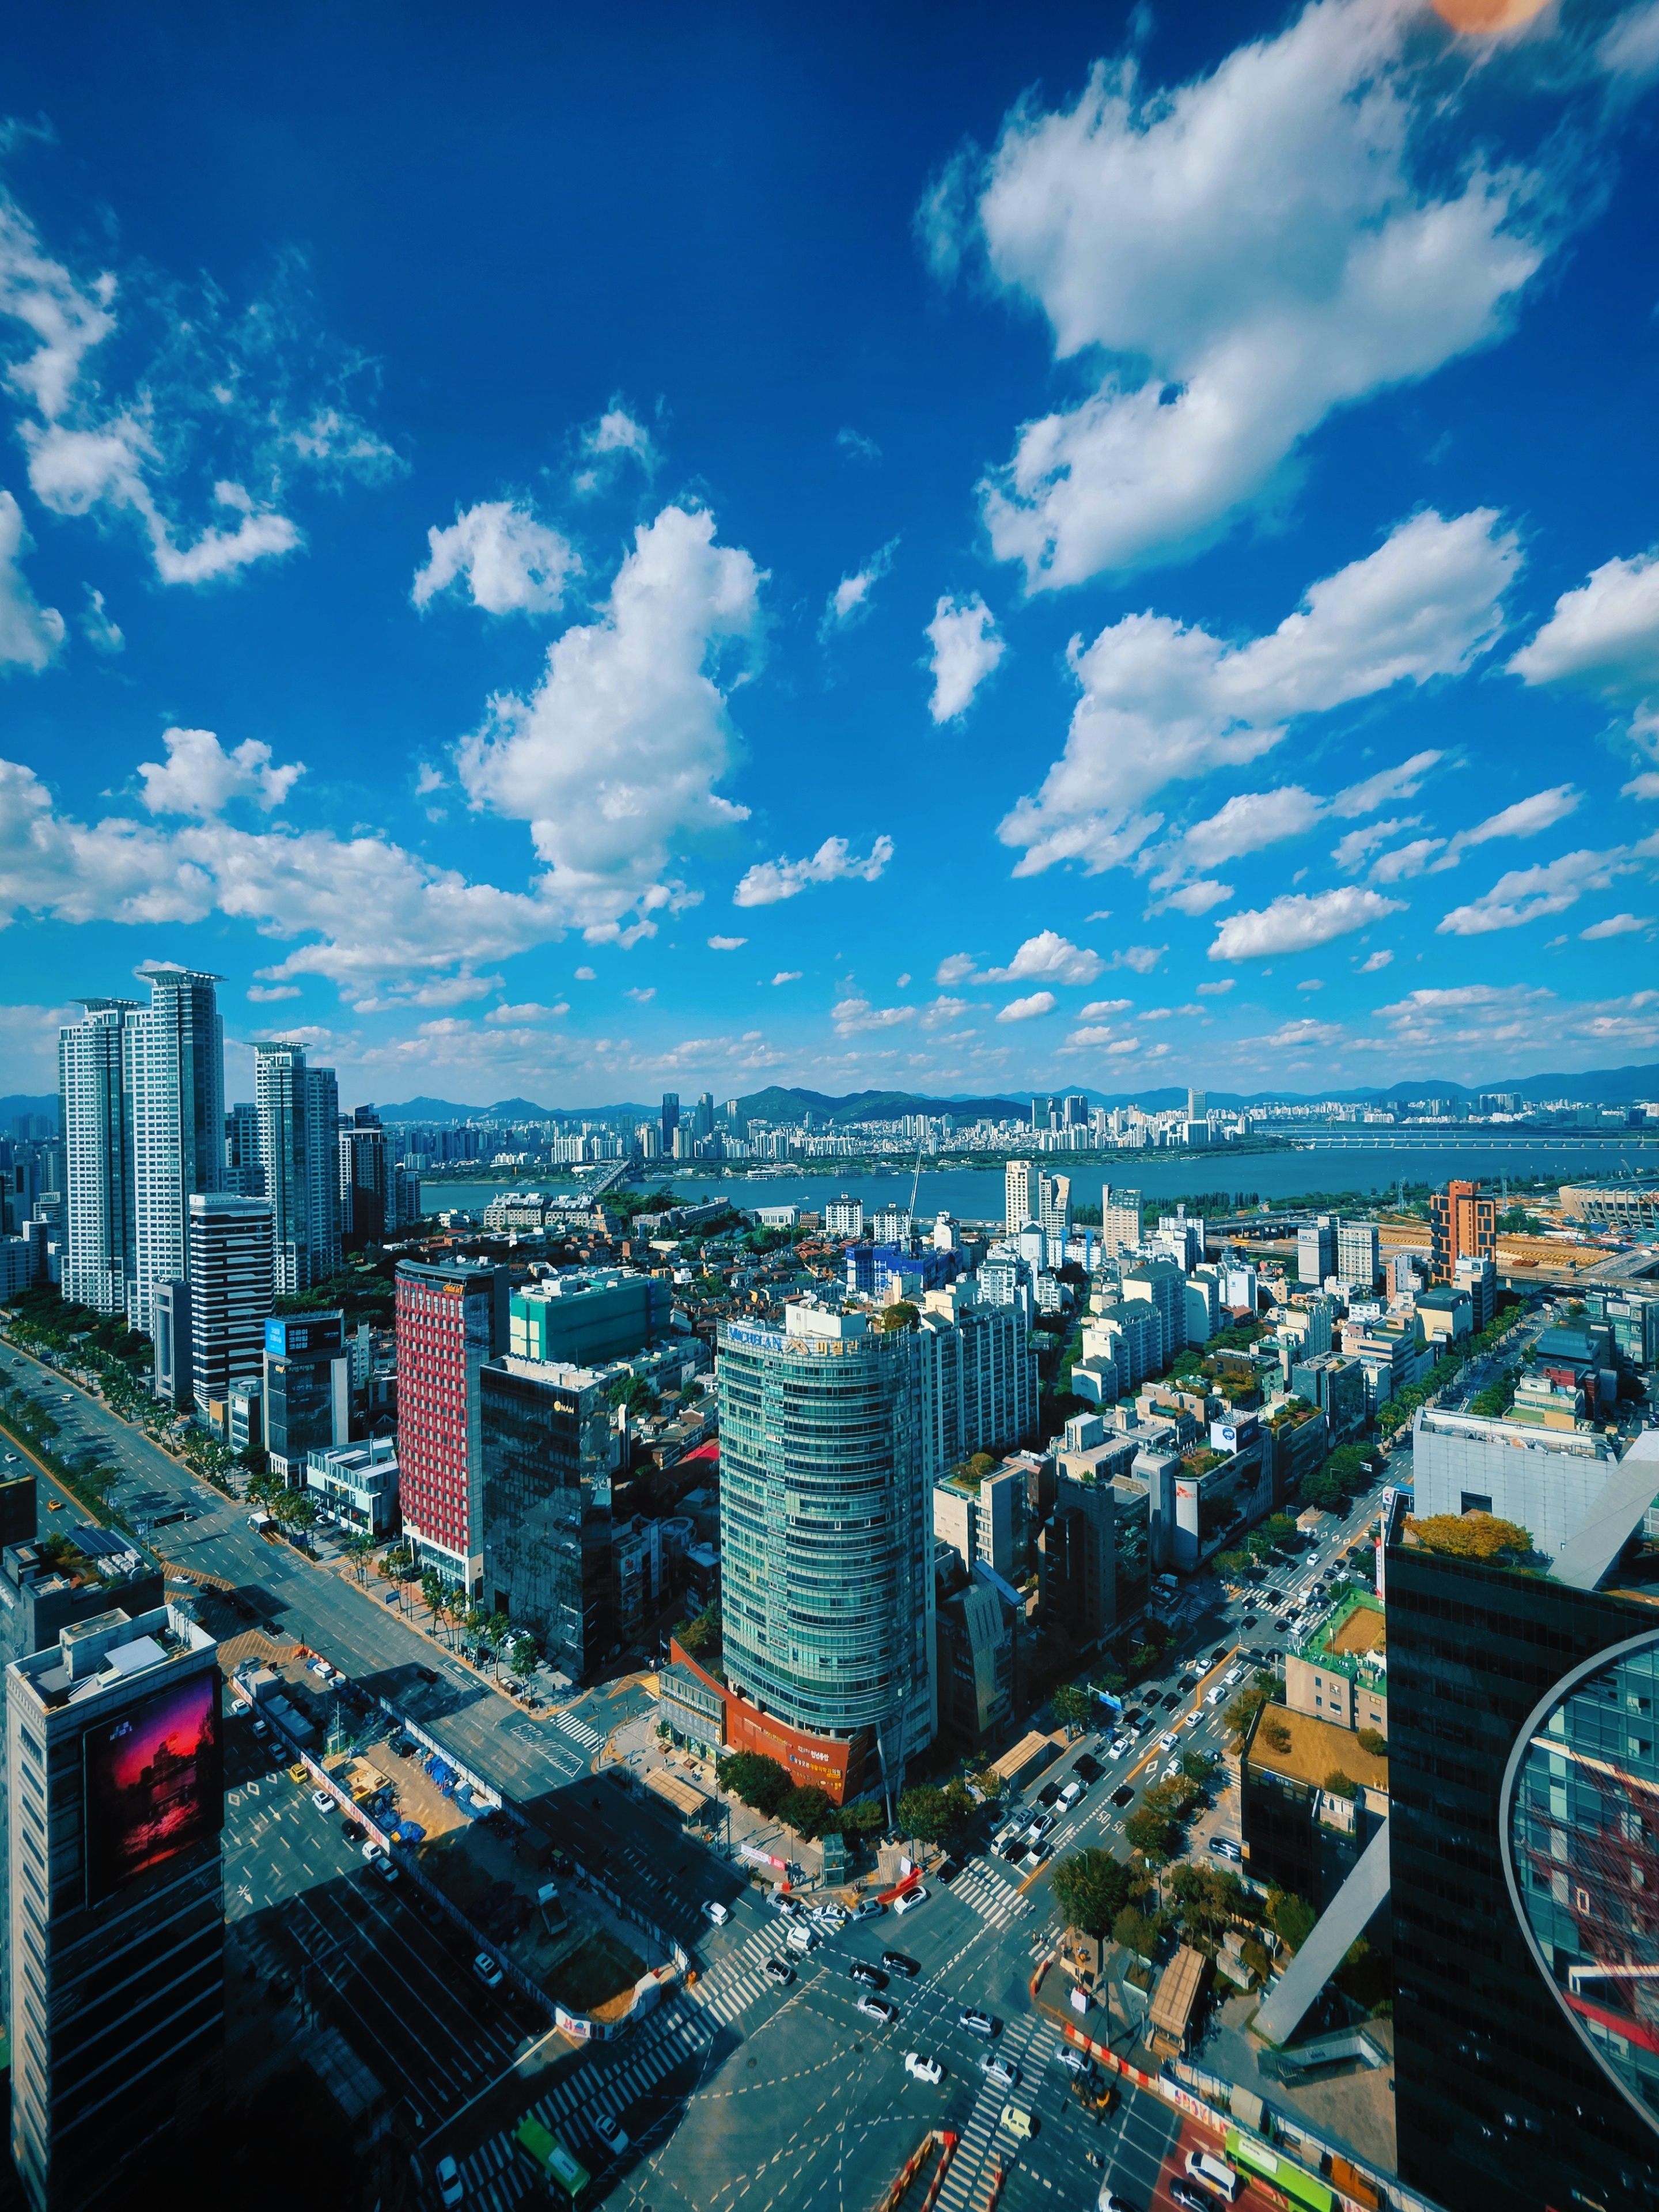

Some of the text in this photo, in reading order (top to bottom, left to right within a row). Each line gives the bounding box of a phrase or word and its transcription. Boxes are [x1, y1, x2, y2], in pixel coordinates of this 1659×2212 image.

[816, 1339, 859, 1356] 미켈란
[1096, 1810, 1112, 1824] 50
[1112, 1820, 1126, 1835] 50
